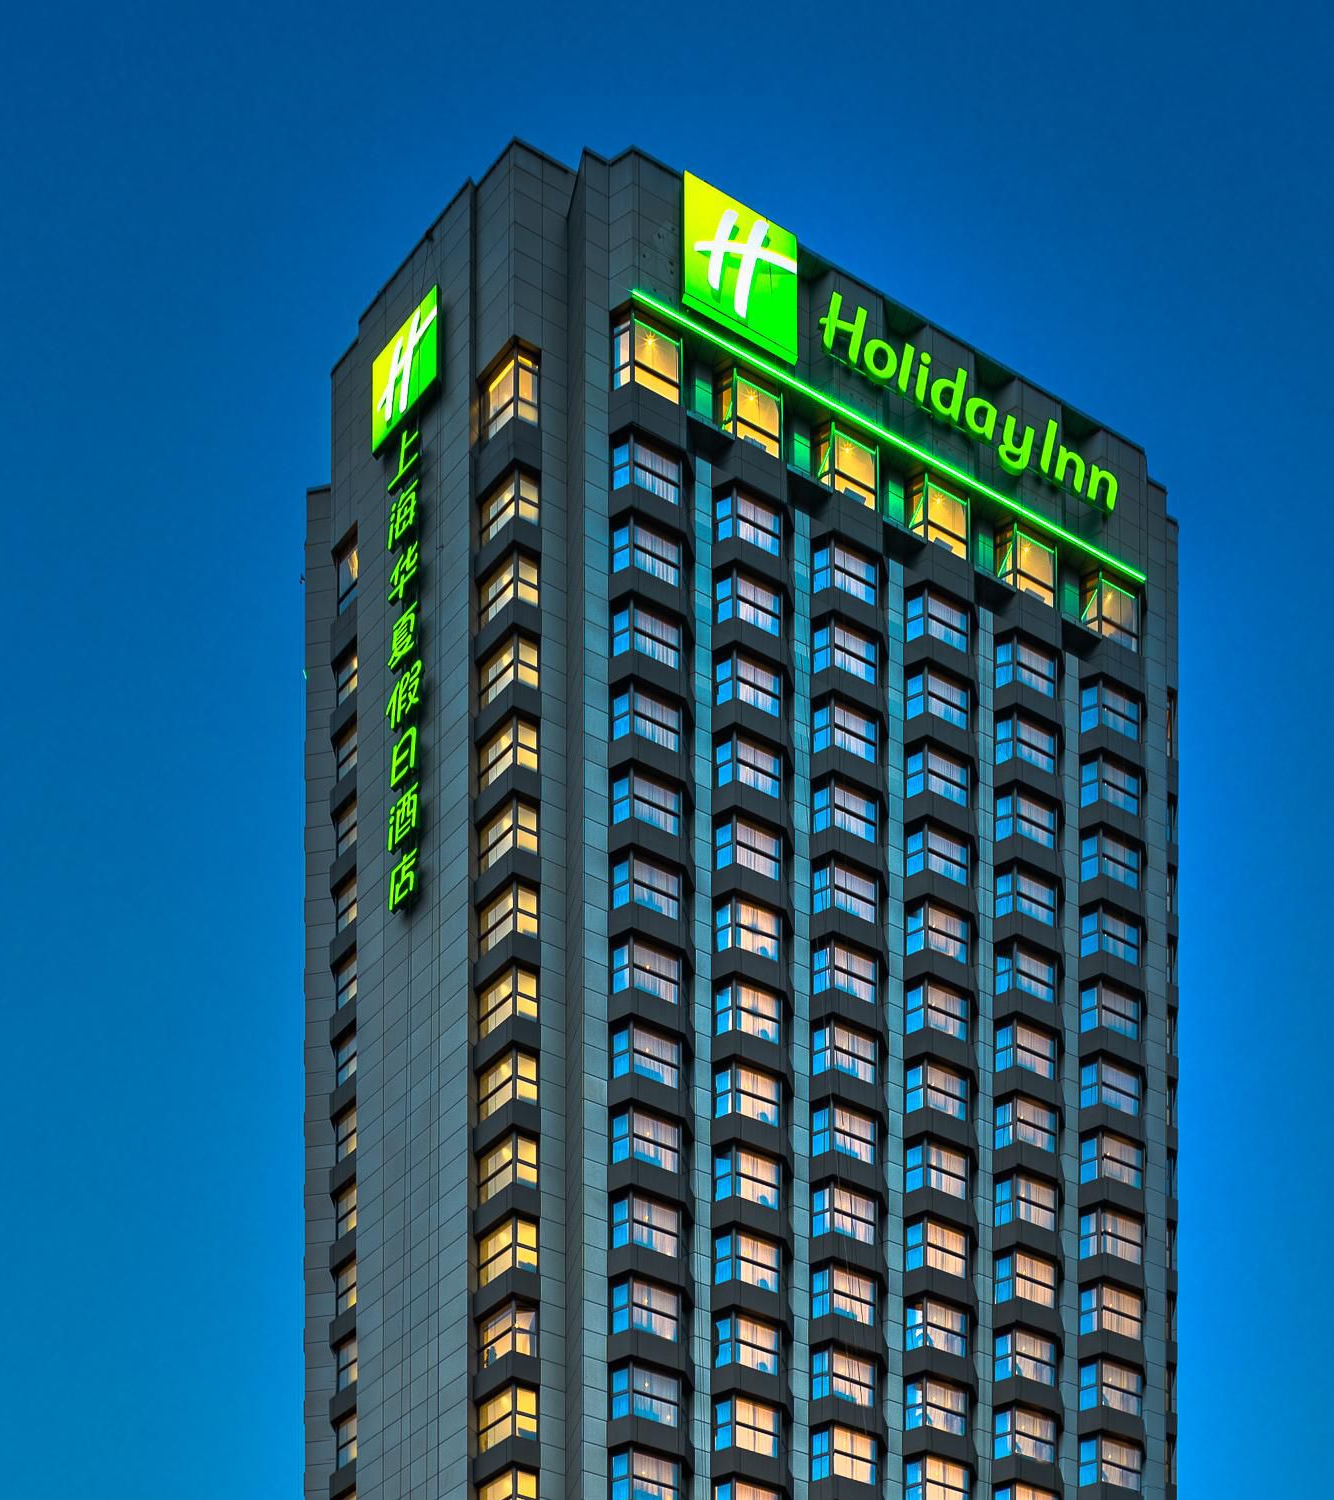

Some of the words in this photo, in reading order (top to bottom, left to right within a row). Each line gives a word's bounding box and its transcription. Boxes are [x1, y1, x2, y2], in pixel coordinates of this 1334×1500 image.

[818, 291, 1036, 476] Holiday
[1040, 419, 1119, 514] Inn
[386, 430, 422, 911] 上海华夏假日酒店
